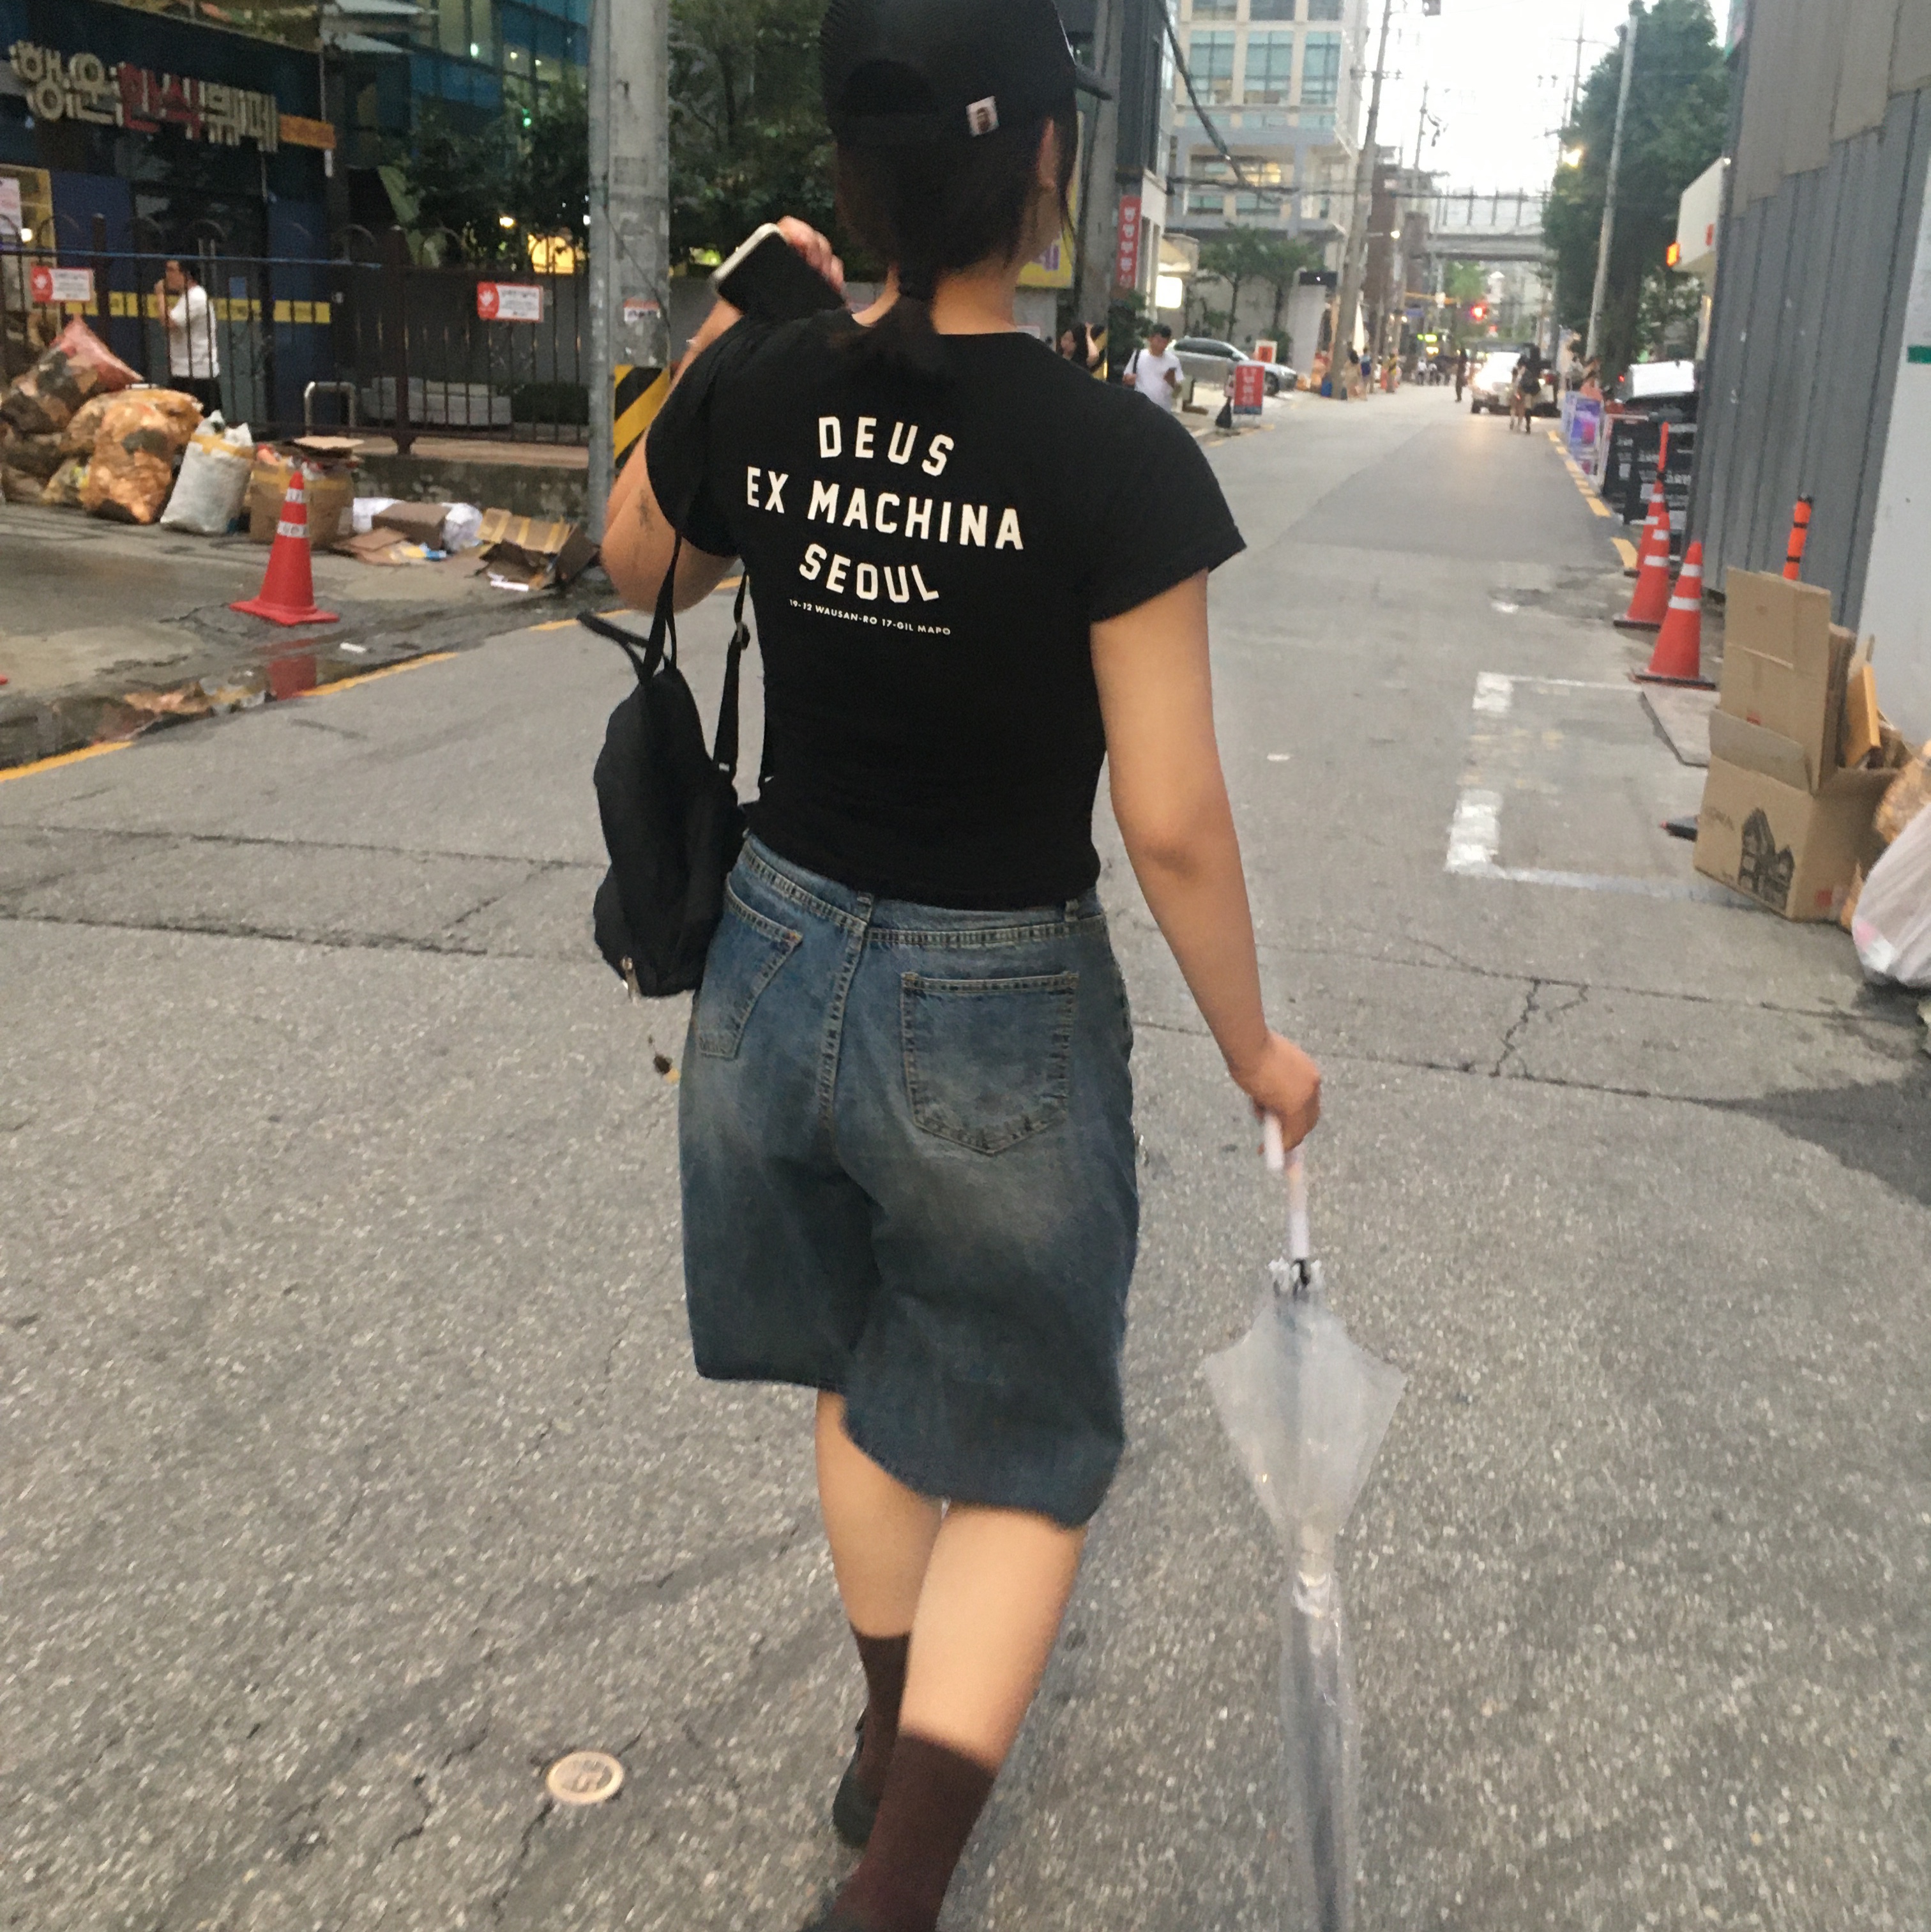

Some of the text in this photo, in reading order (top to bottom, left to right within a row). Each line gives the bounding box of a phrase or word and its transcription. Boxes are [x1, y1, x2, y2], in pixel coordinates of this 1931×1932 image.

[818, 416, 955, 477] DEUS
[746, 466, 1024, 551] EX MACHINA
[799, 543, 939, 604] SEOUL
[789, 598, 951, 635] 19-12 WAUSAN-RO 17-GIL MAPO
